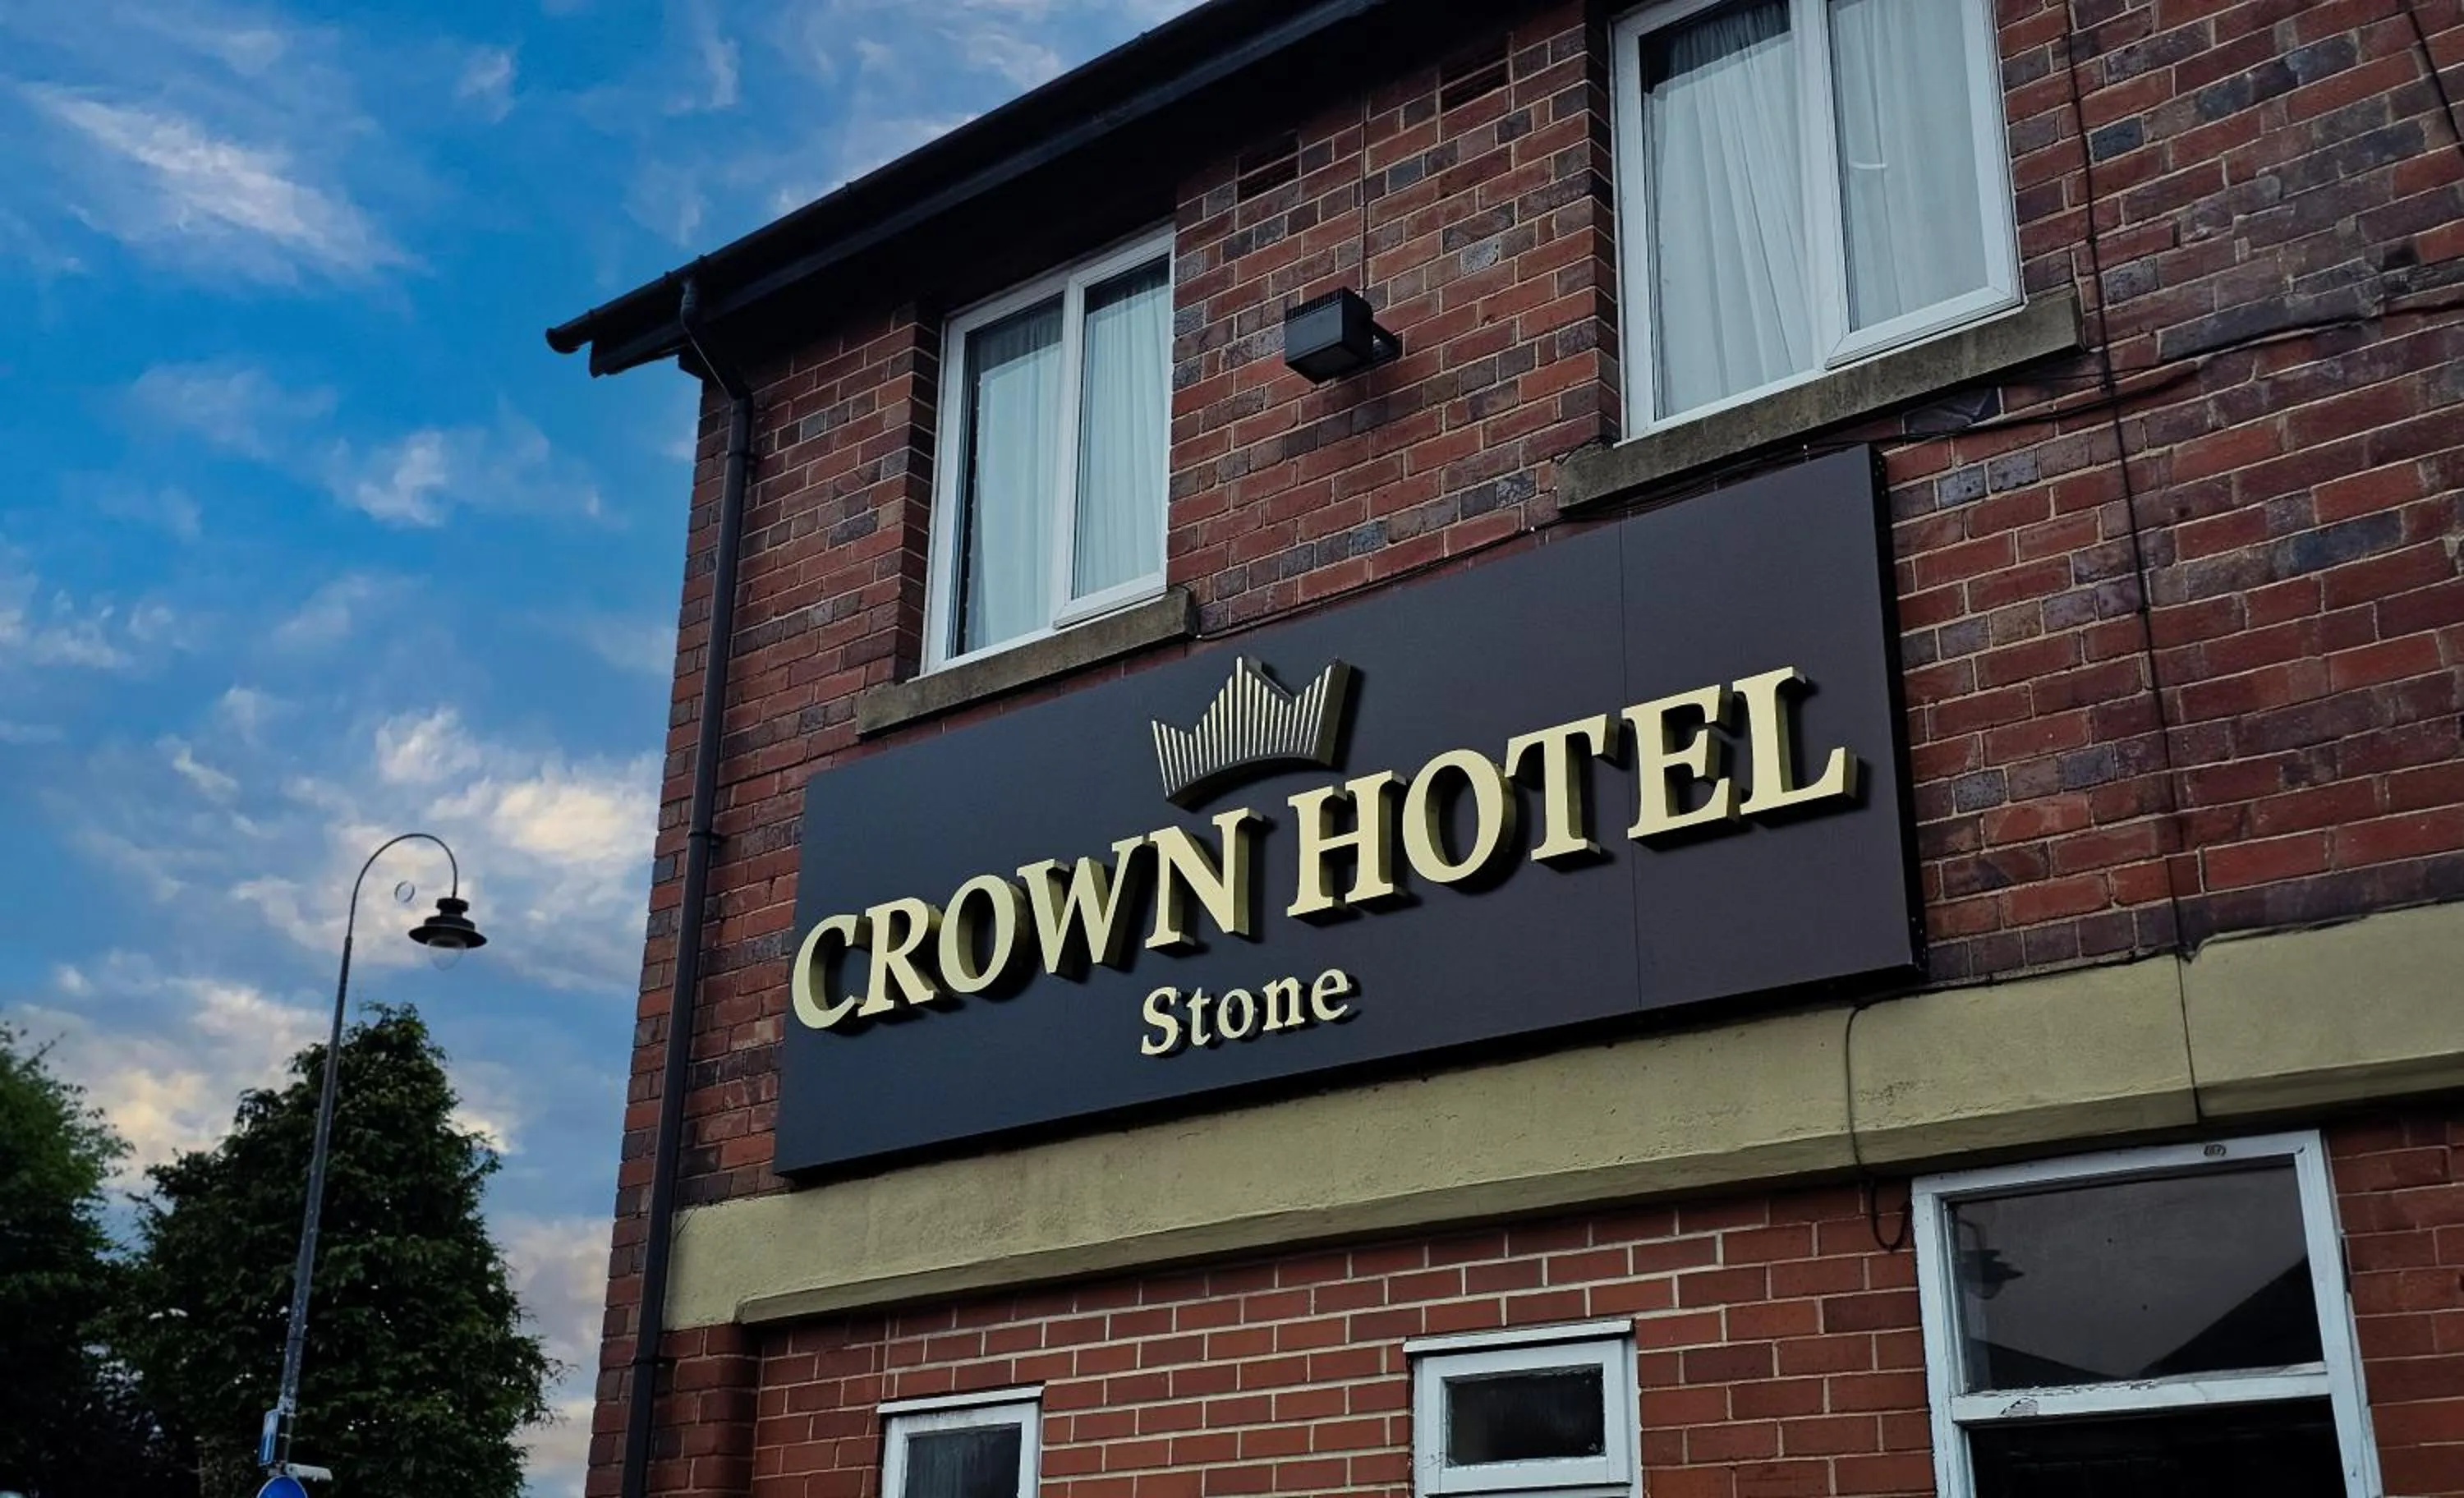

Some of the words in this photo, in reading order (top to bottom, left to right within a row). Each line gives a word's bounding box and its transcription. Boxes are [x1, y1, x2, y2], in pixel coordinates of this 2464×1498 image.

[790, 808, 1263, 1030] CROWN
[1287, 666, 1856, 918] HOTEL
[1141, 967, 1350, 1056] Stone
